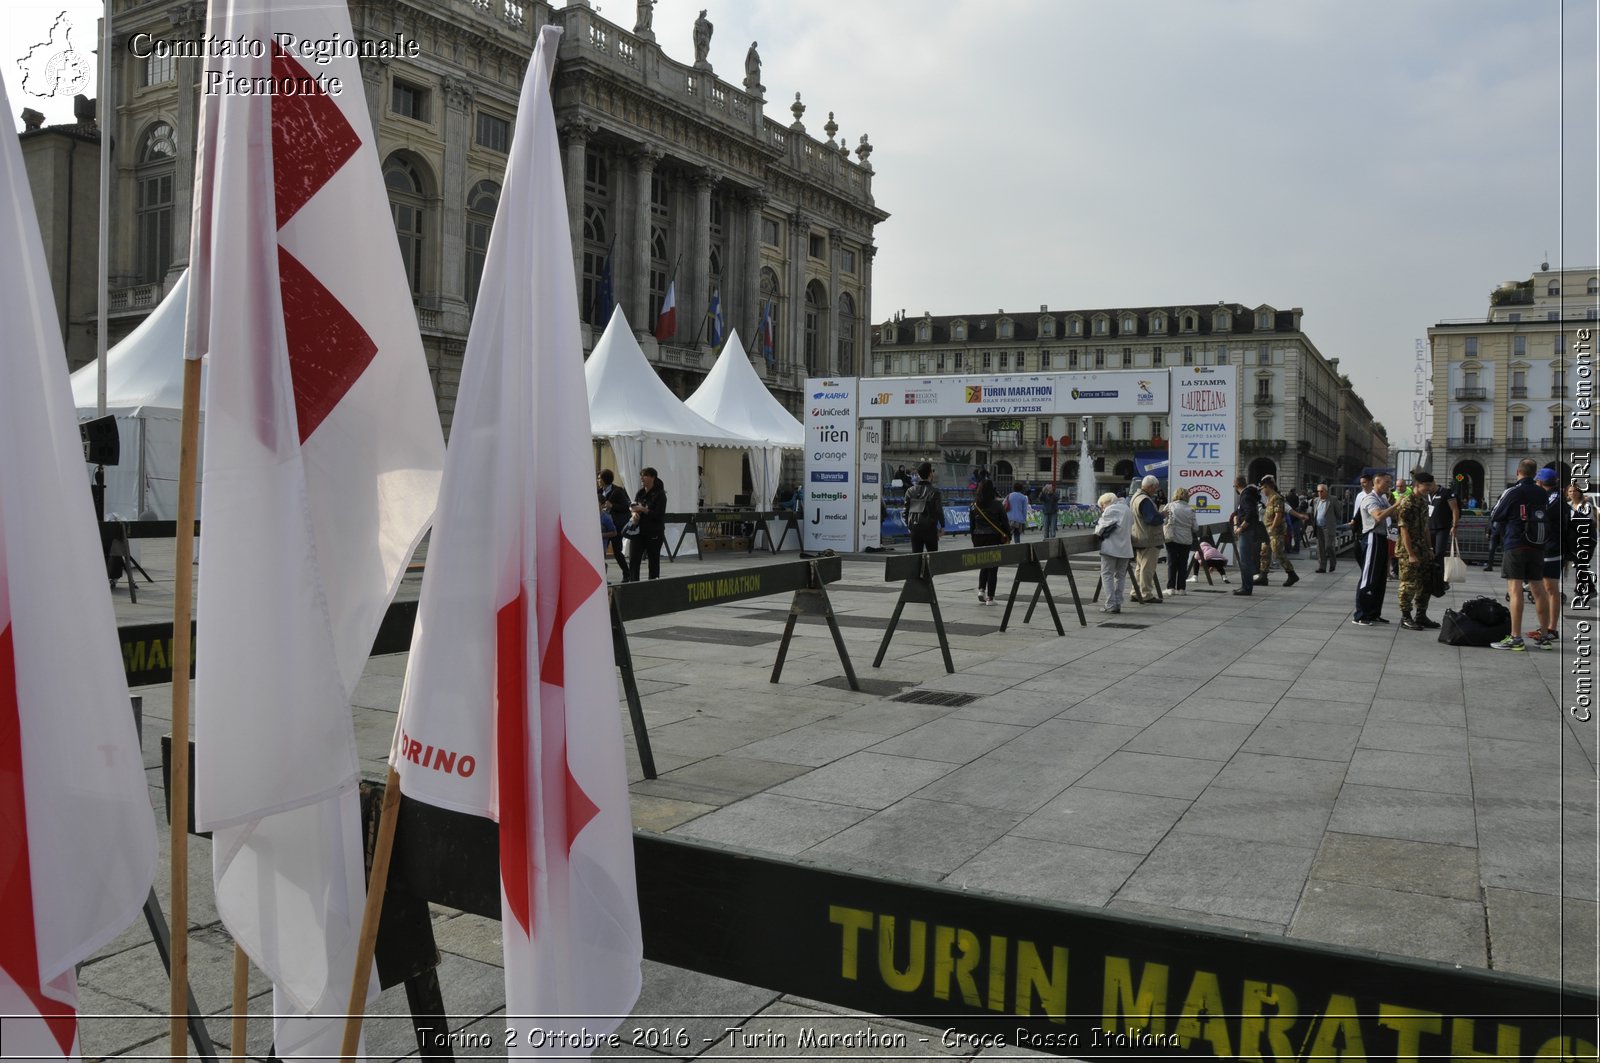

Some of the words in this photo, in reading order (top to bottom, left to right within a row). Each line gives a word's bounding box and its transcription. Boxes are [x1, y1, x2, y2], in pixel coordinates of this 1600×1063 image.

[1414, 338, 1425, 396] REALE
[825, 392, 849, 400] KARHU
[983, 387, 1007, 397] TURIN
[1007, 386, 1053, 396] MARATHON
[1181, 390, 1227, 412] LAURETANA
[820, 408, 850, 417] UniCredit
[820, 428, 849, 443] iren
[866, 430, 880, 444] iren
[1187, 442, 1220, 459] ZTE
[1179, 469, 1224, 477] GIMAX
[811, 492, 848, 501] battaglio
[811, 508, 820, 525] J
[687, 580, 714, 602] TURIN
[716, 574, 760, 597] MARATHON
[402, 729, 476, 778] ORINO
[829, 904, 1070, 1025] TURIN
